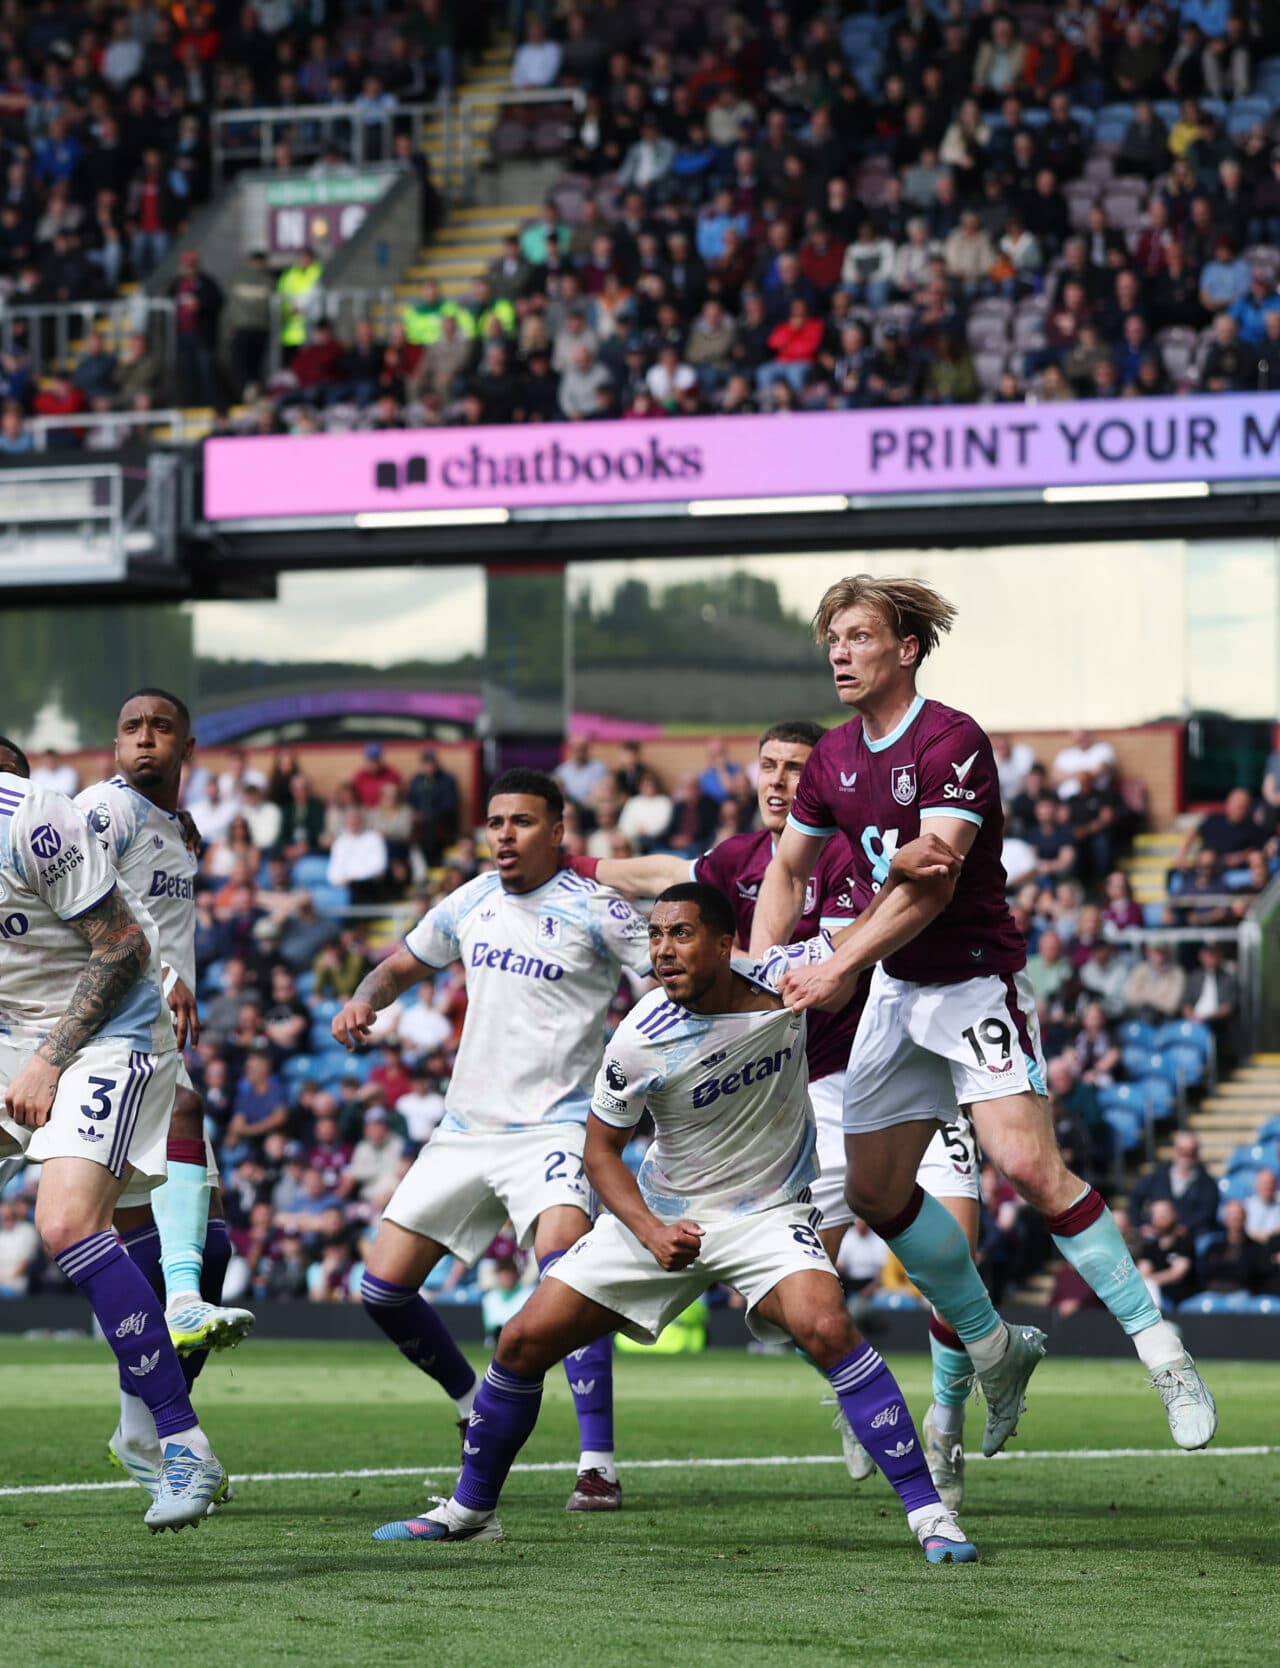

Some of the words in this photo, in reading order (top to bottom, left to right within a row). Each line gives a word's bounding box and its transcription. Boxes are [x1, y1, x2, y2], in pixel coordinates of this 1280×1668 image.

[441, 436, 703, 488] chatbooks
[869, 422, 1039, 471] PRINT
[1058, 415, 1218, 464] YOUR
[943, 783, 976, 801] Sure
[40, 845, 79, 878] TRADE
[45, 854, 85, 887] NATION
[472, 942, 564, 982] Betano
[961, 1017, 1011, 1067] 19
[80, 1075, 117, 1121] 3
[692, 1047, 792, 1110] Betan
[544, 1150, 586, 1183] 27
